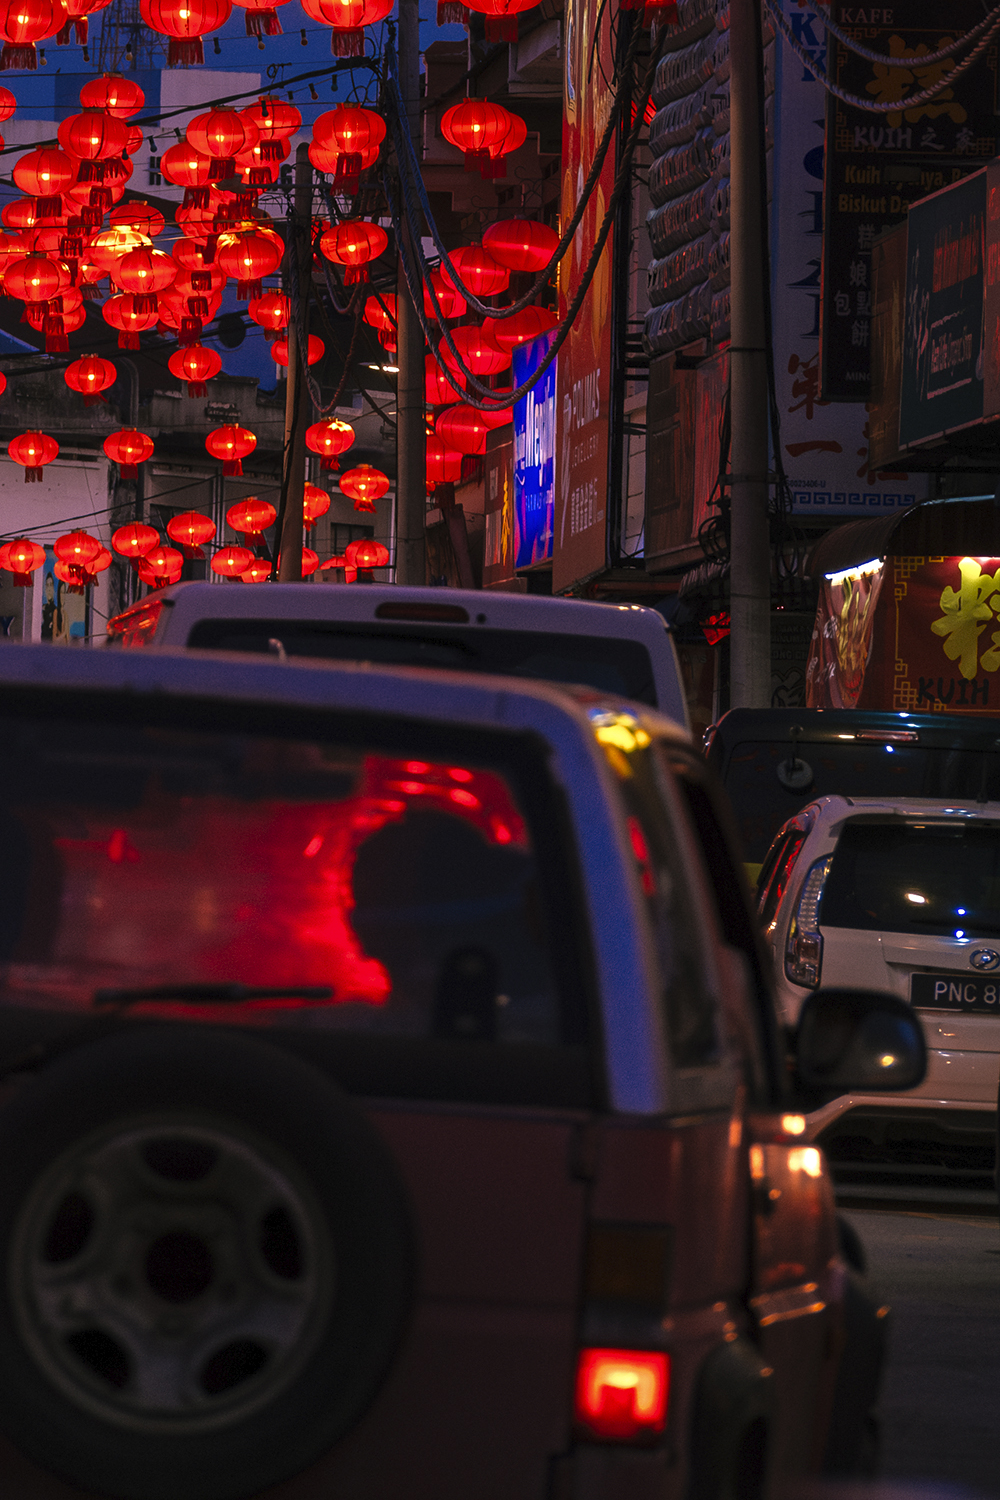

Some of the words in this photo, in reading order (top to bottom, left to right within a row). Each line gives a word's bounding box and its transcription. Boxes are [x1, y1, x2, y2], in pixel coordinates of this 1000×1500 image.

[840, 7, 894, 24] KAFE
[853, 126, 913, 150] KUIH
[844, 164, 881, 184] Kuih
[838, 193, 887, 214] Biskut
[916, 676, 990, 706] KUIH
[934, 980, 978, 1004] PNC
[983, 984, 1000, 1005] 8
